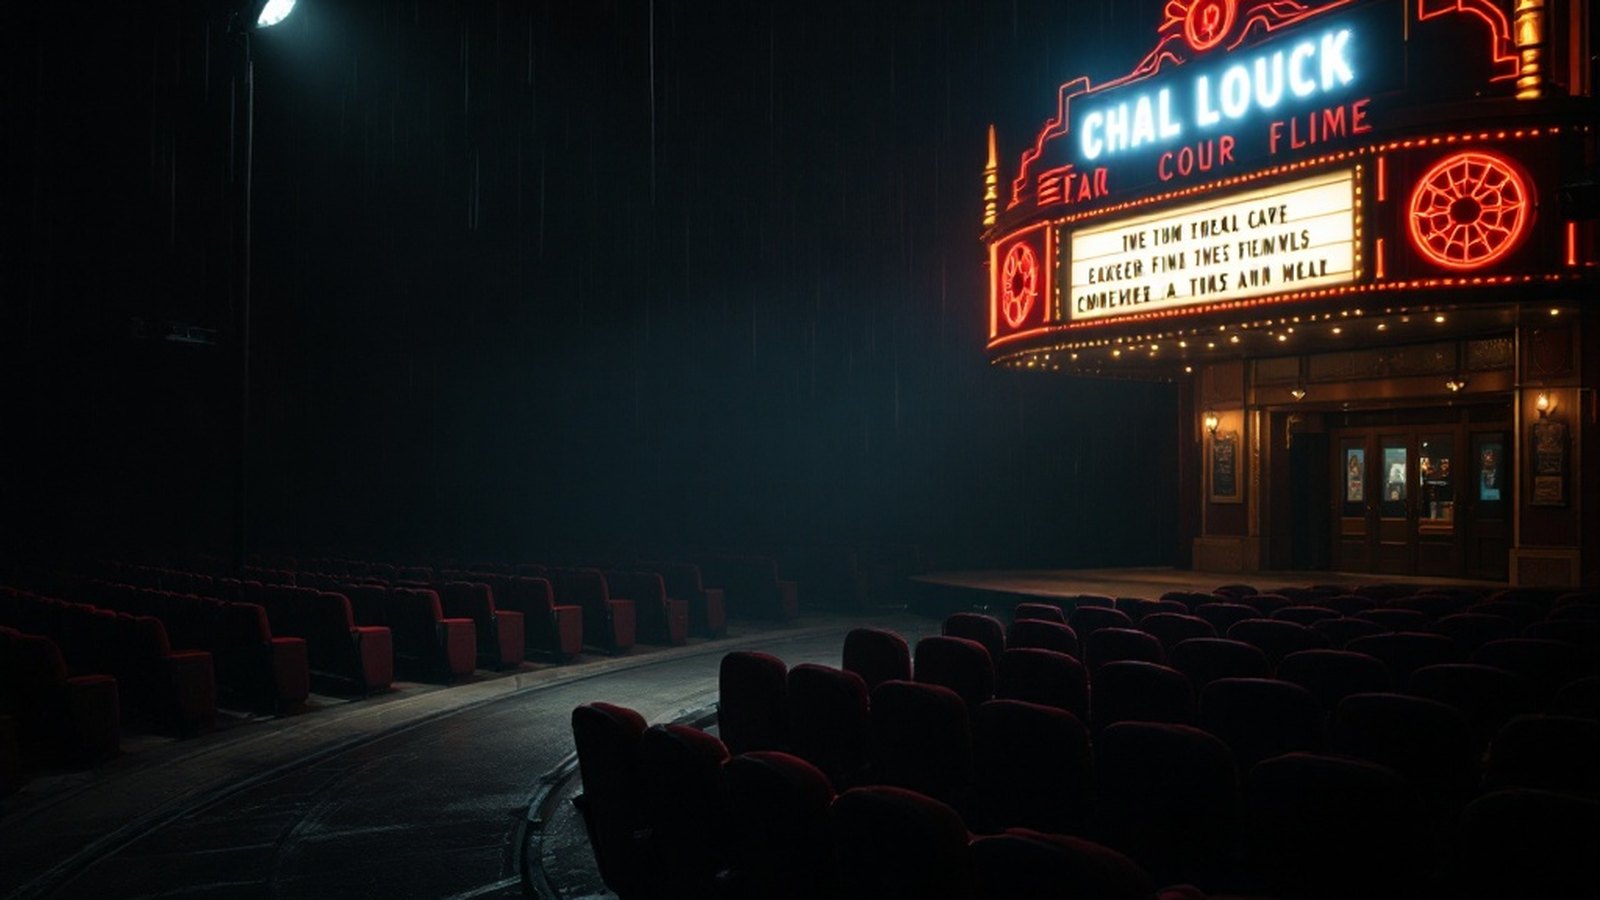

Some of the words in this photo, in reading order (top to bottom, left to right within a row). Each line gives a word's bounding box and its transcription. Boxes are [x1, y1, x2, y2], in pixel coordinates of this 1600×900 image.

[1081, 90, 1182, 160] CHAL
[1196, 28, 1355, 127] LOUCK
[1158, 135, 1236, 182] COUR
[1269, 98, 1373, 154] FLIME
